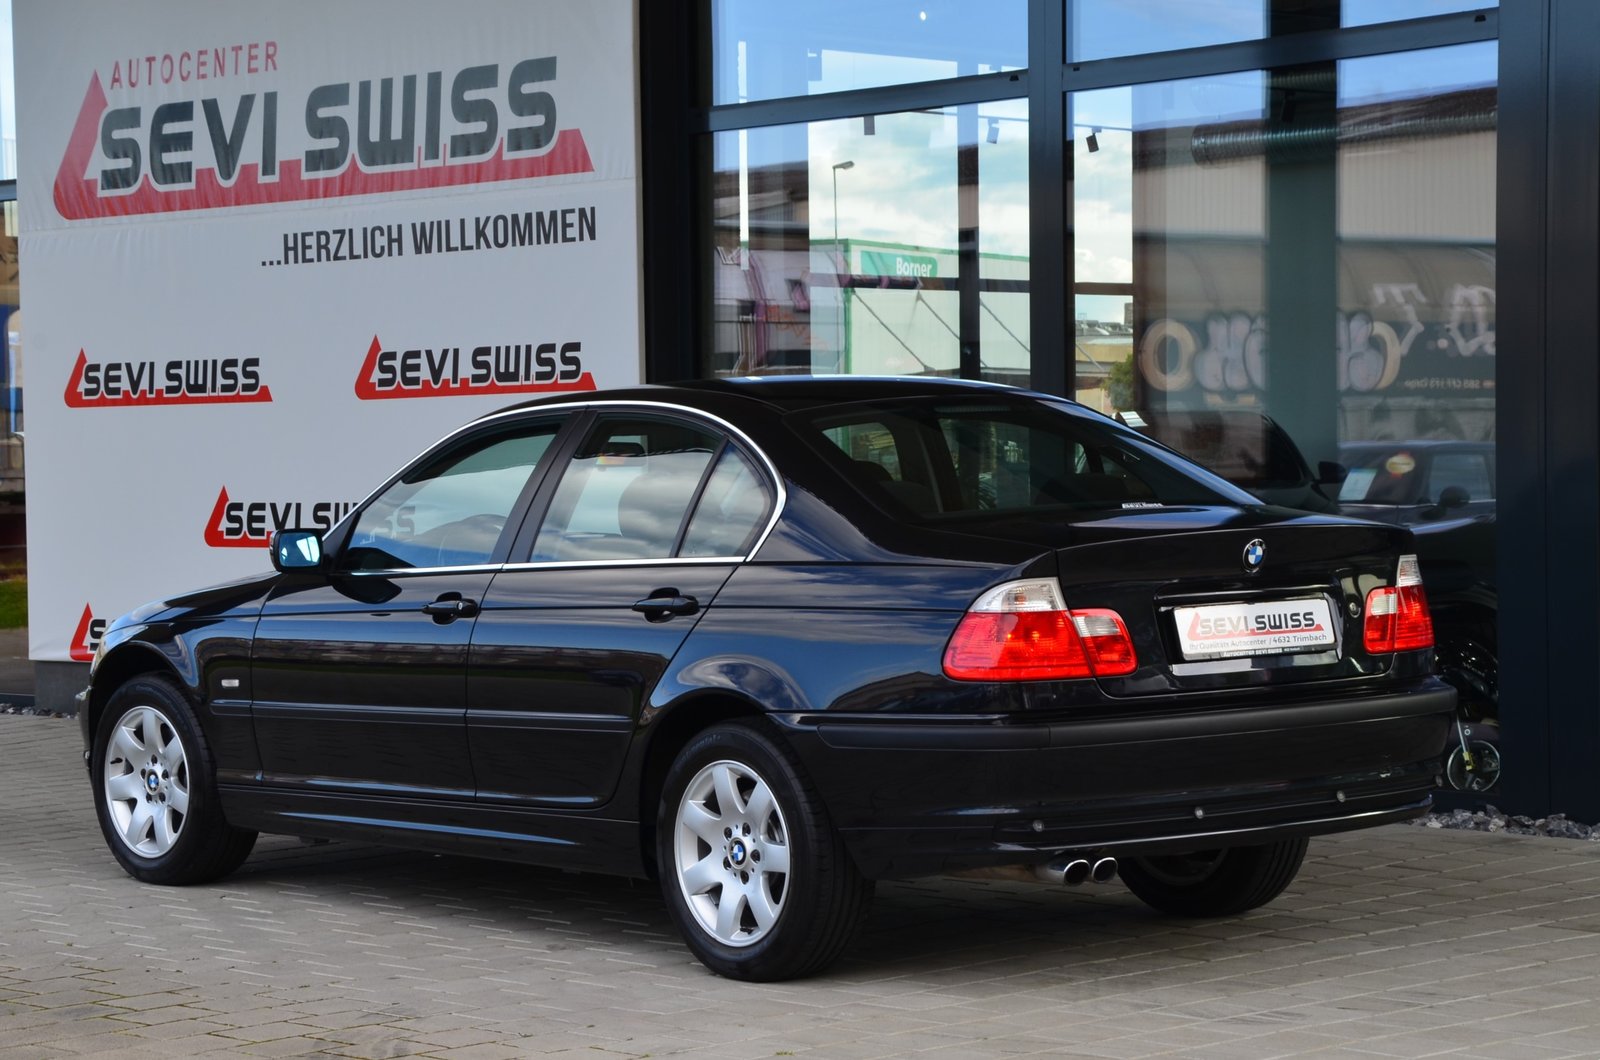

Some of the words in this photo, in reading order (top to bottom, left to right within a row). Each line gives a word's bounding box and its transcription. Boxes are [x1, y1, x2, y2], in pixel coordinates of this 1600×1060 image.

[110, 41, 279, 90] AUTOCENTER
[100, 91, 278, 192] SEVI
[304, 56, 558, 174] SWISS
[261, 223, 403, 267] ...HERZLICH
[411, 206, 597, 256] WILLKOMMEN
[896, 256, 932, 278] Borner
[84, 362, 155, 398] SEVI
[165, 358, 260, 394] SWISS
[377, 349, 460, 390] SEVI
[471, 342, 582, 385] SWISS
[225, 502, 301, 537] SEVI
[1199, 615, 1250, 635] SEVI
[1254, 611, 1315, 631] SWISS
[1231, 638, 1266, 648] Autocenter
[1273, 636, 1291, 644] 4632
[1293, 633, 1327, 643] Trimbach
